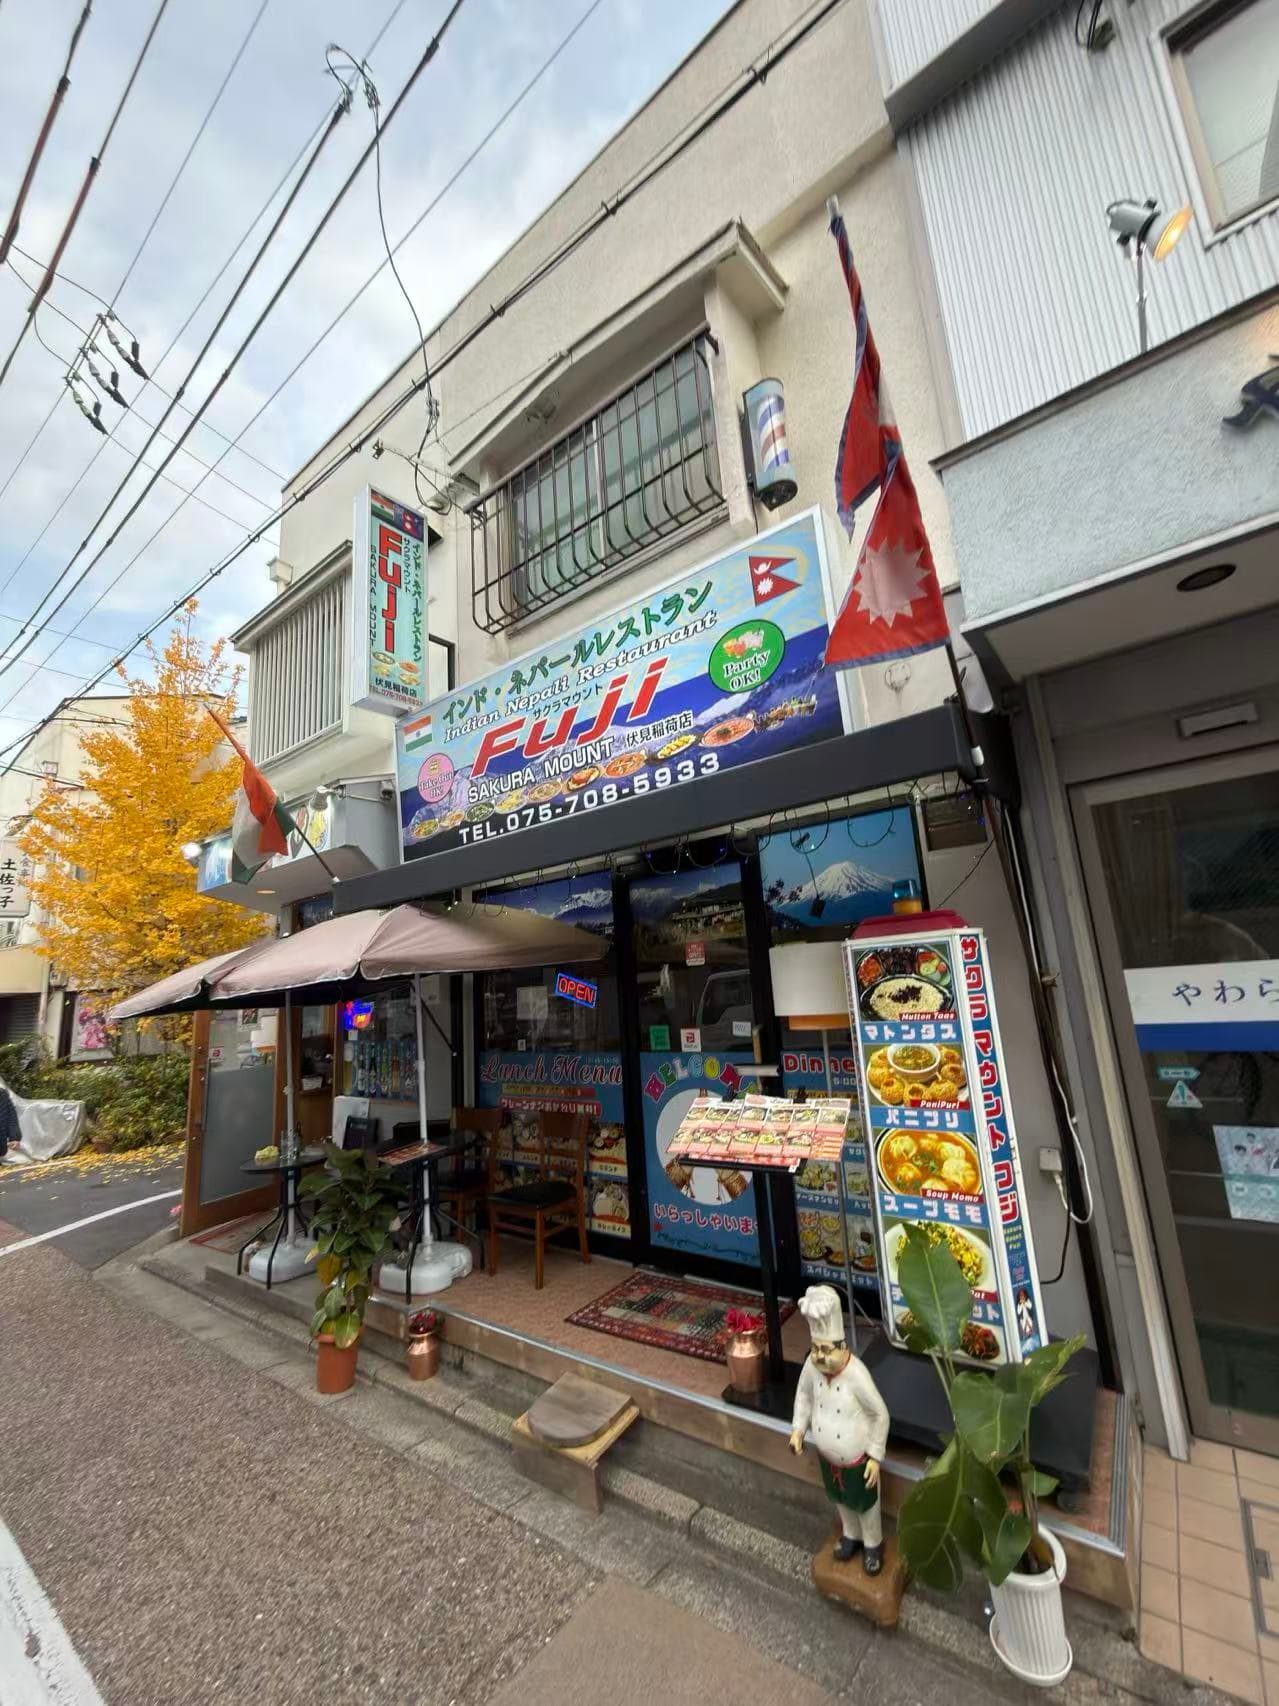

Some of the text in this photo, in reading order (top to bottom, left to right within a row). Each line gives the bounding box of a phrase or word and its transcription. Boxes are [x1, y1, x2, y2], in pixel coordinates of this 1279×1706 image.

[369, 545, 377, 648] SAKURA MOUNT
[442, 580, 714, 725] インド・ネパールレストラン
[723, 650, 769, 678] Party
[443, 608, 718, 743] Indian Nepali Restaurant
[729, 669, 761, 690] OK!
[533, 683, 604, 719] サクラマウント
[626, 710, 694, 748] 伏見稲荷店
[468, 737, 615, 802] SAKURA MOUNT
[459, 752, 720, 845] TEL.075-708-5933
[0, 858, 17, 909] 土佐っ子
[558, 977, 594, 1003] OPEN
[960, 936, 988, 1020] サクラ
[864, 1024, 957, 1041] マトンタス
[901, 1013, 931, 1021] Mutton
[479, 1053, 624, 1086] Lunch Menu
[783, 1053, 856, 1074] Dinne
[973, 1029, 1006, 1150] マウント
[883, 1194, 982, 1224] スープモモ
[926, 1190, 979, 1203] Soup Momo
[994, 1160, 1019, 1225] フジ
[654, 1203, 758, 1236] いらっしゃいま
